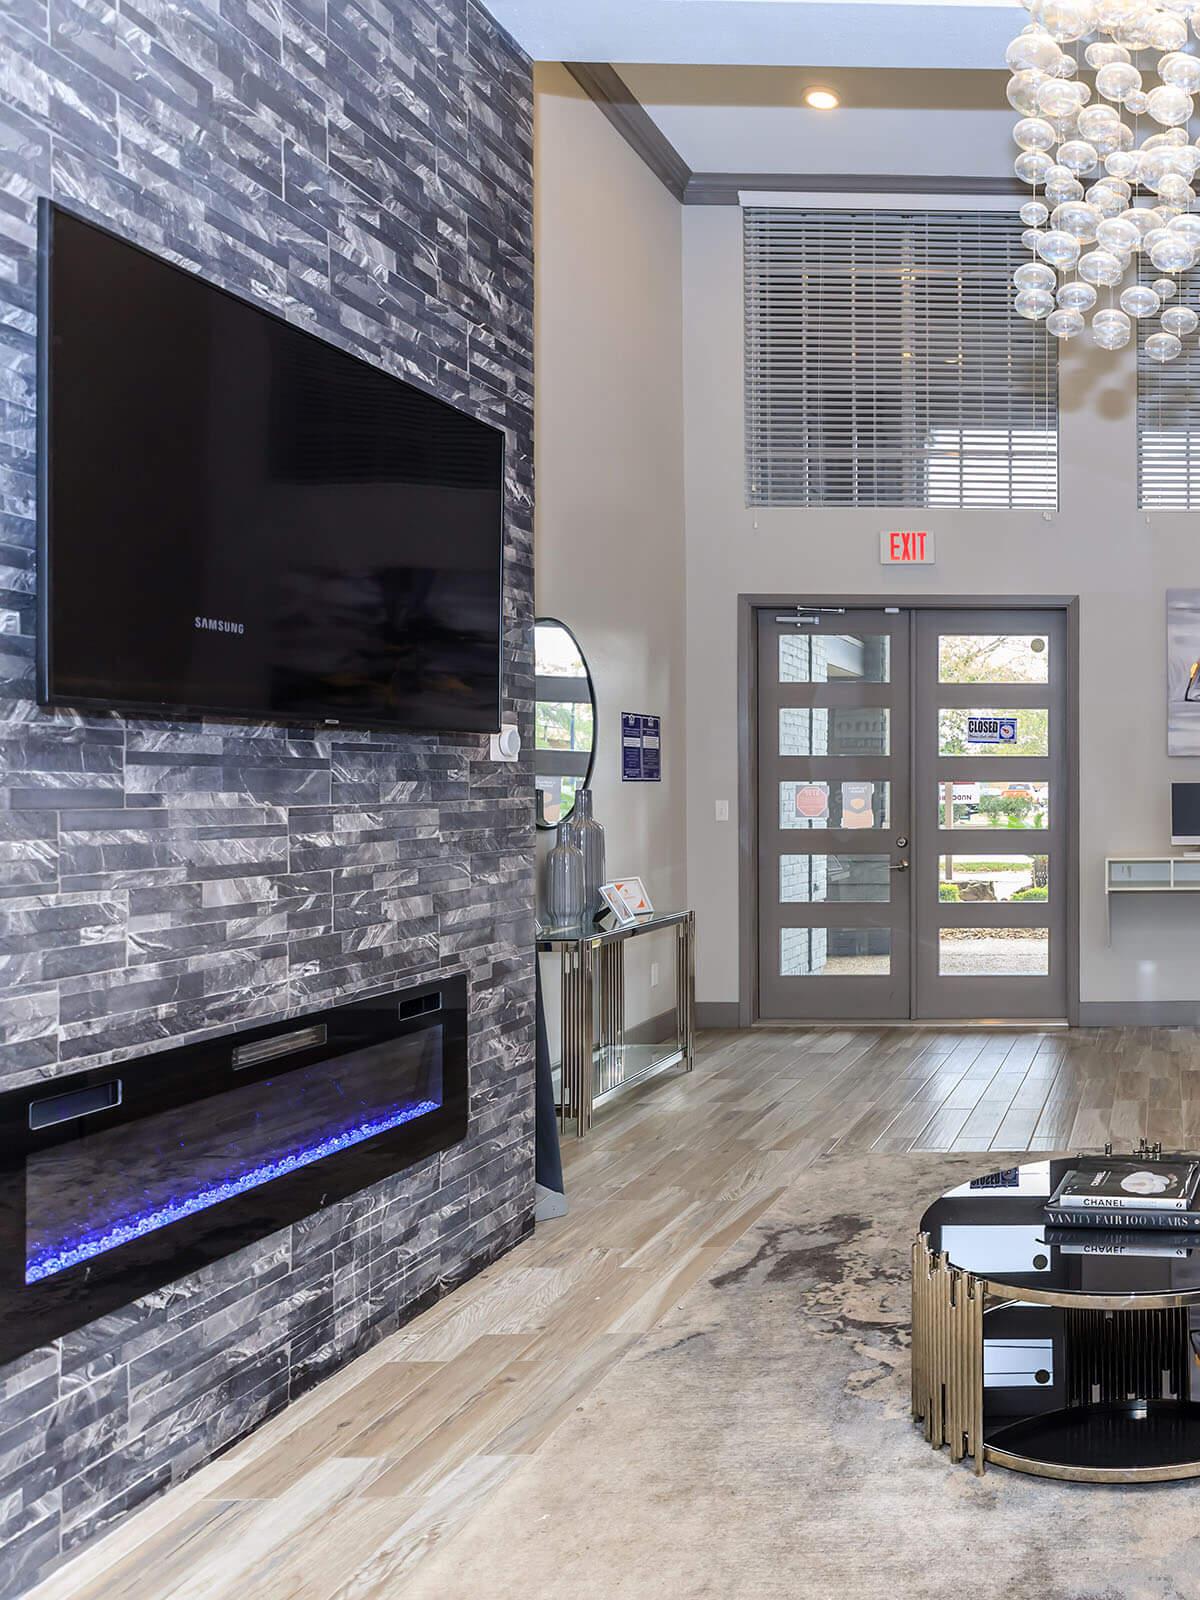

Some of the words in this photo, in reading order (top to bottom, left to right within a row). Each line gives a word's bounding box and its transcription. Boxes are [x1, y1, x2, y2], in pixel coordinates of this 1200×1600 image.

[889, 532, 927, 561] EXIT
[195, 616, 244, 634] SAMSUNG
[968, 720, 998, 733] CLOSED
[1083, 1198, 1125, 1207] CHANEL
[1048, 1213, 1091, 1224] VANITY
[1095, 1214, 1122, 1225] FAIR
[1125, 1215, 1147, 1225] 100
[1150, 1217, 1188, 1227] YEARS
